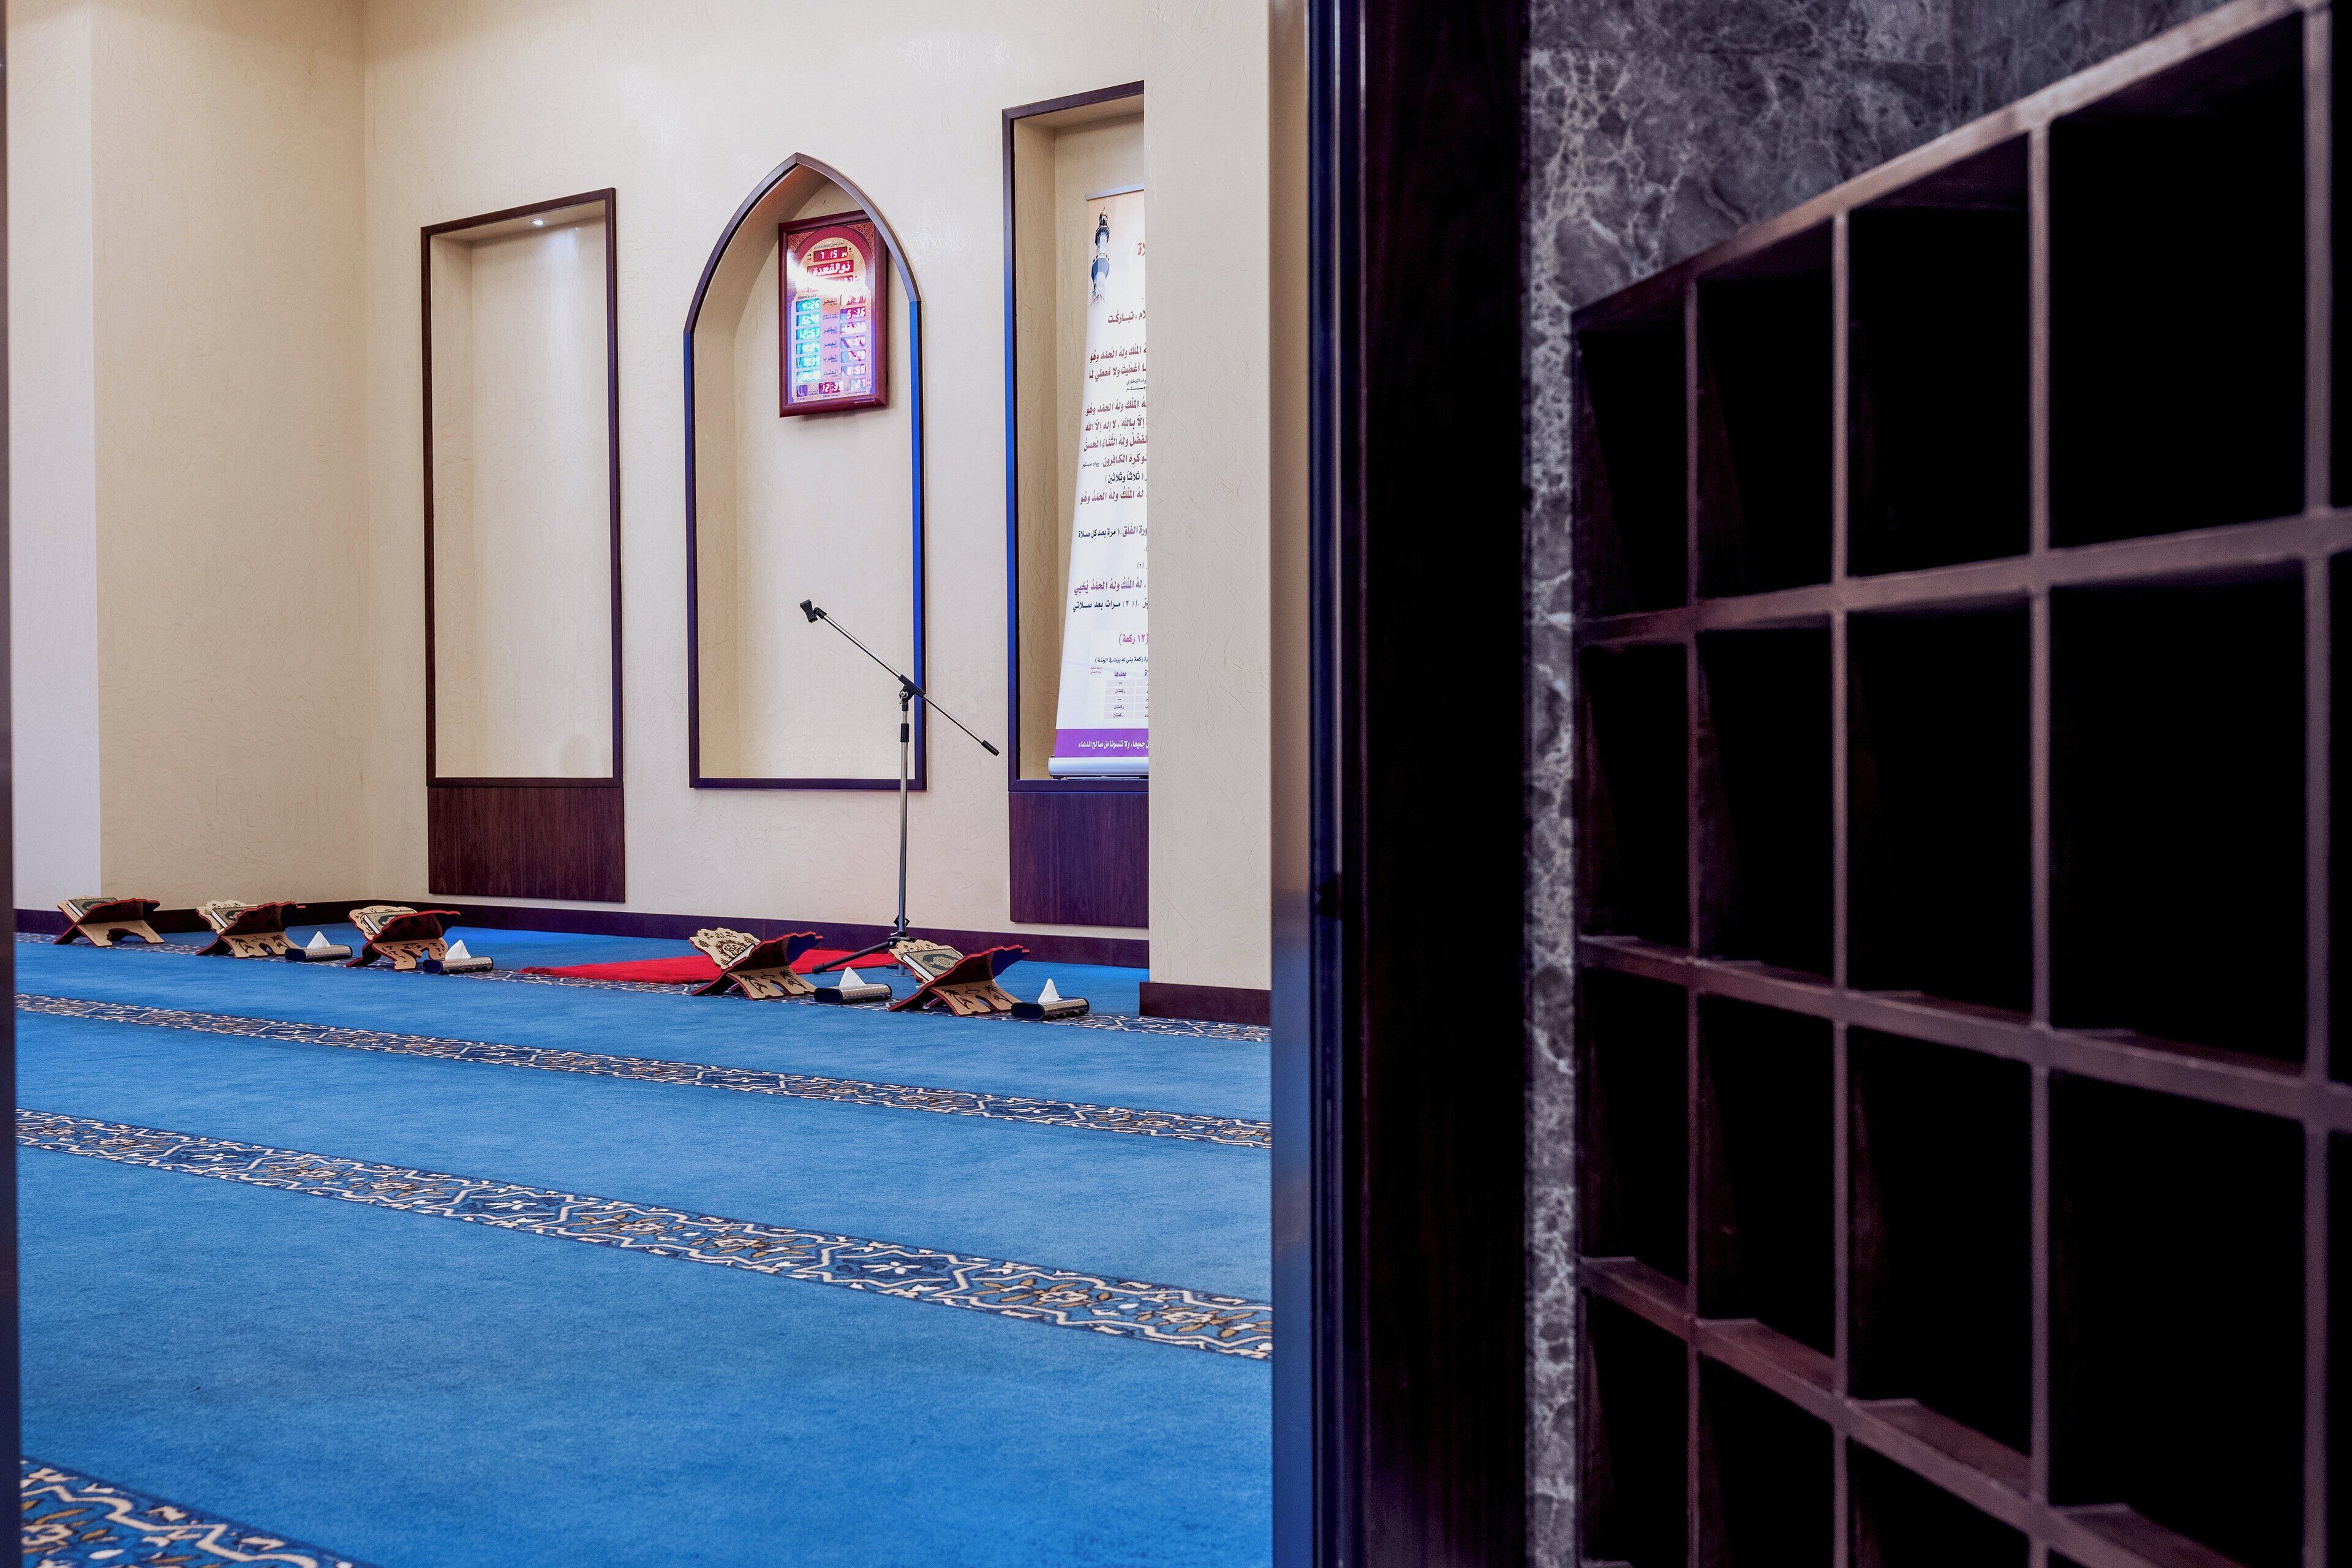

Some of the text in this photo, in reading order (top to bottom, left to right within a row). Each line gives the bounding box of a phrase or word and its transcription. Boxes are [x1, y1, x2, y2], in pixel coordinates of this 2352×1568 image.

[1091, 529, 1098, 538] كل
[1098, 529, 1106, 538] بعد
[1094, 601, 1103, 610] بعد
